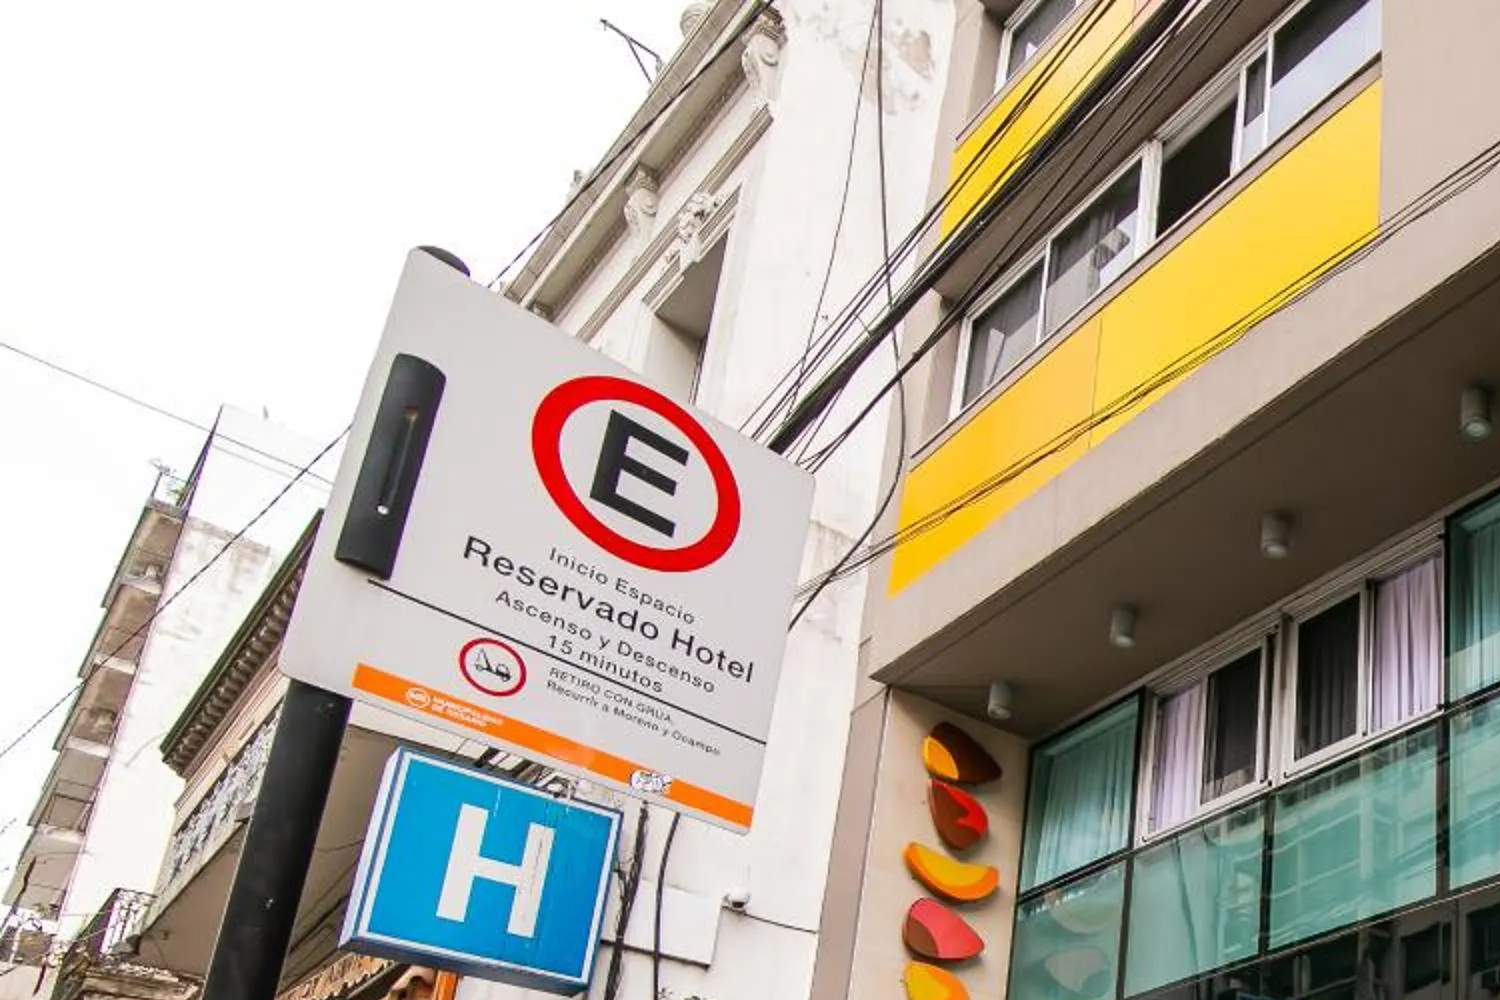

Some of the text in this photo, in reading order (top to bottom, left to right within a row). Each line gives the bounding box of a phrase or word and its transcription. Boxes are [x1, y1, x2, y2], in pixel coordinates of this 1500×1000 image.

[590, 409, 689, 539] E
[463, 536, 755, 683] Reservado Hotel
[549, 547, 695, 626] Inicio Espacio
[496, 590, 715, 693] Ascenso y Descenso
[549, 634, 663, 693] 15 minutos
[549, 667, 601, 695] RETIRO
[603, 689, 633, 707] CON
[436, 802, 557, 938] H
